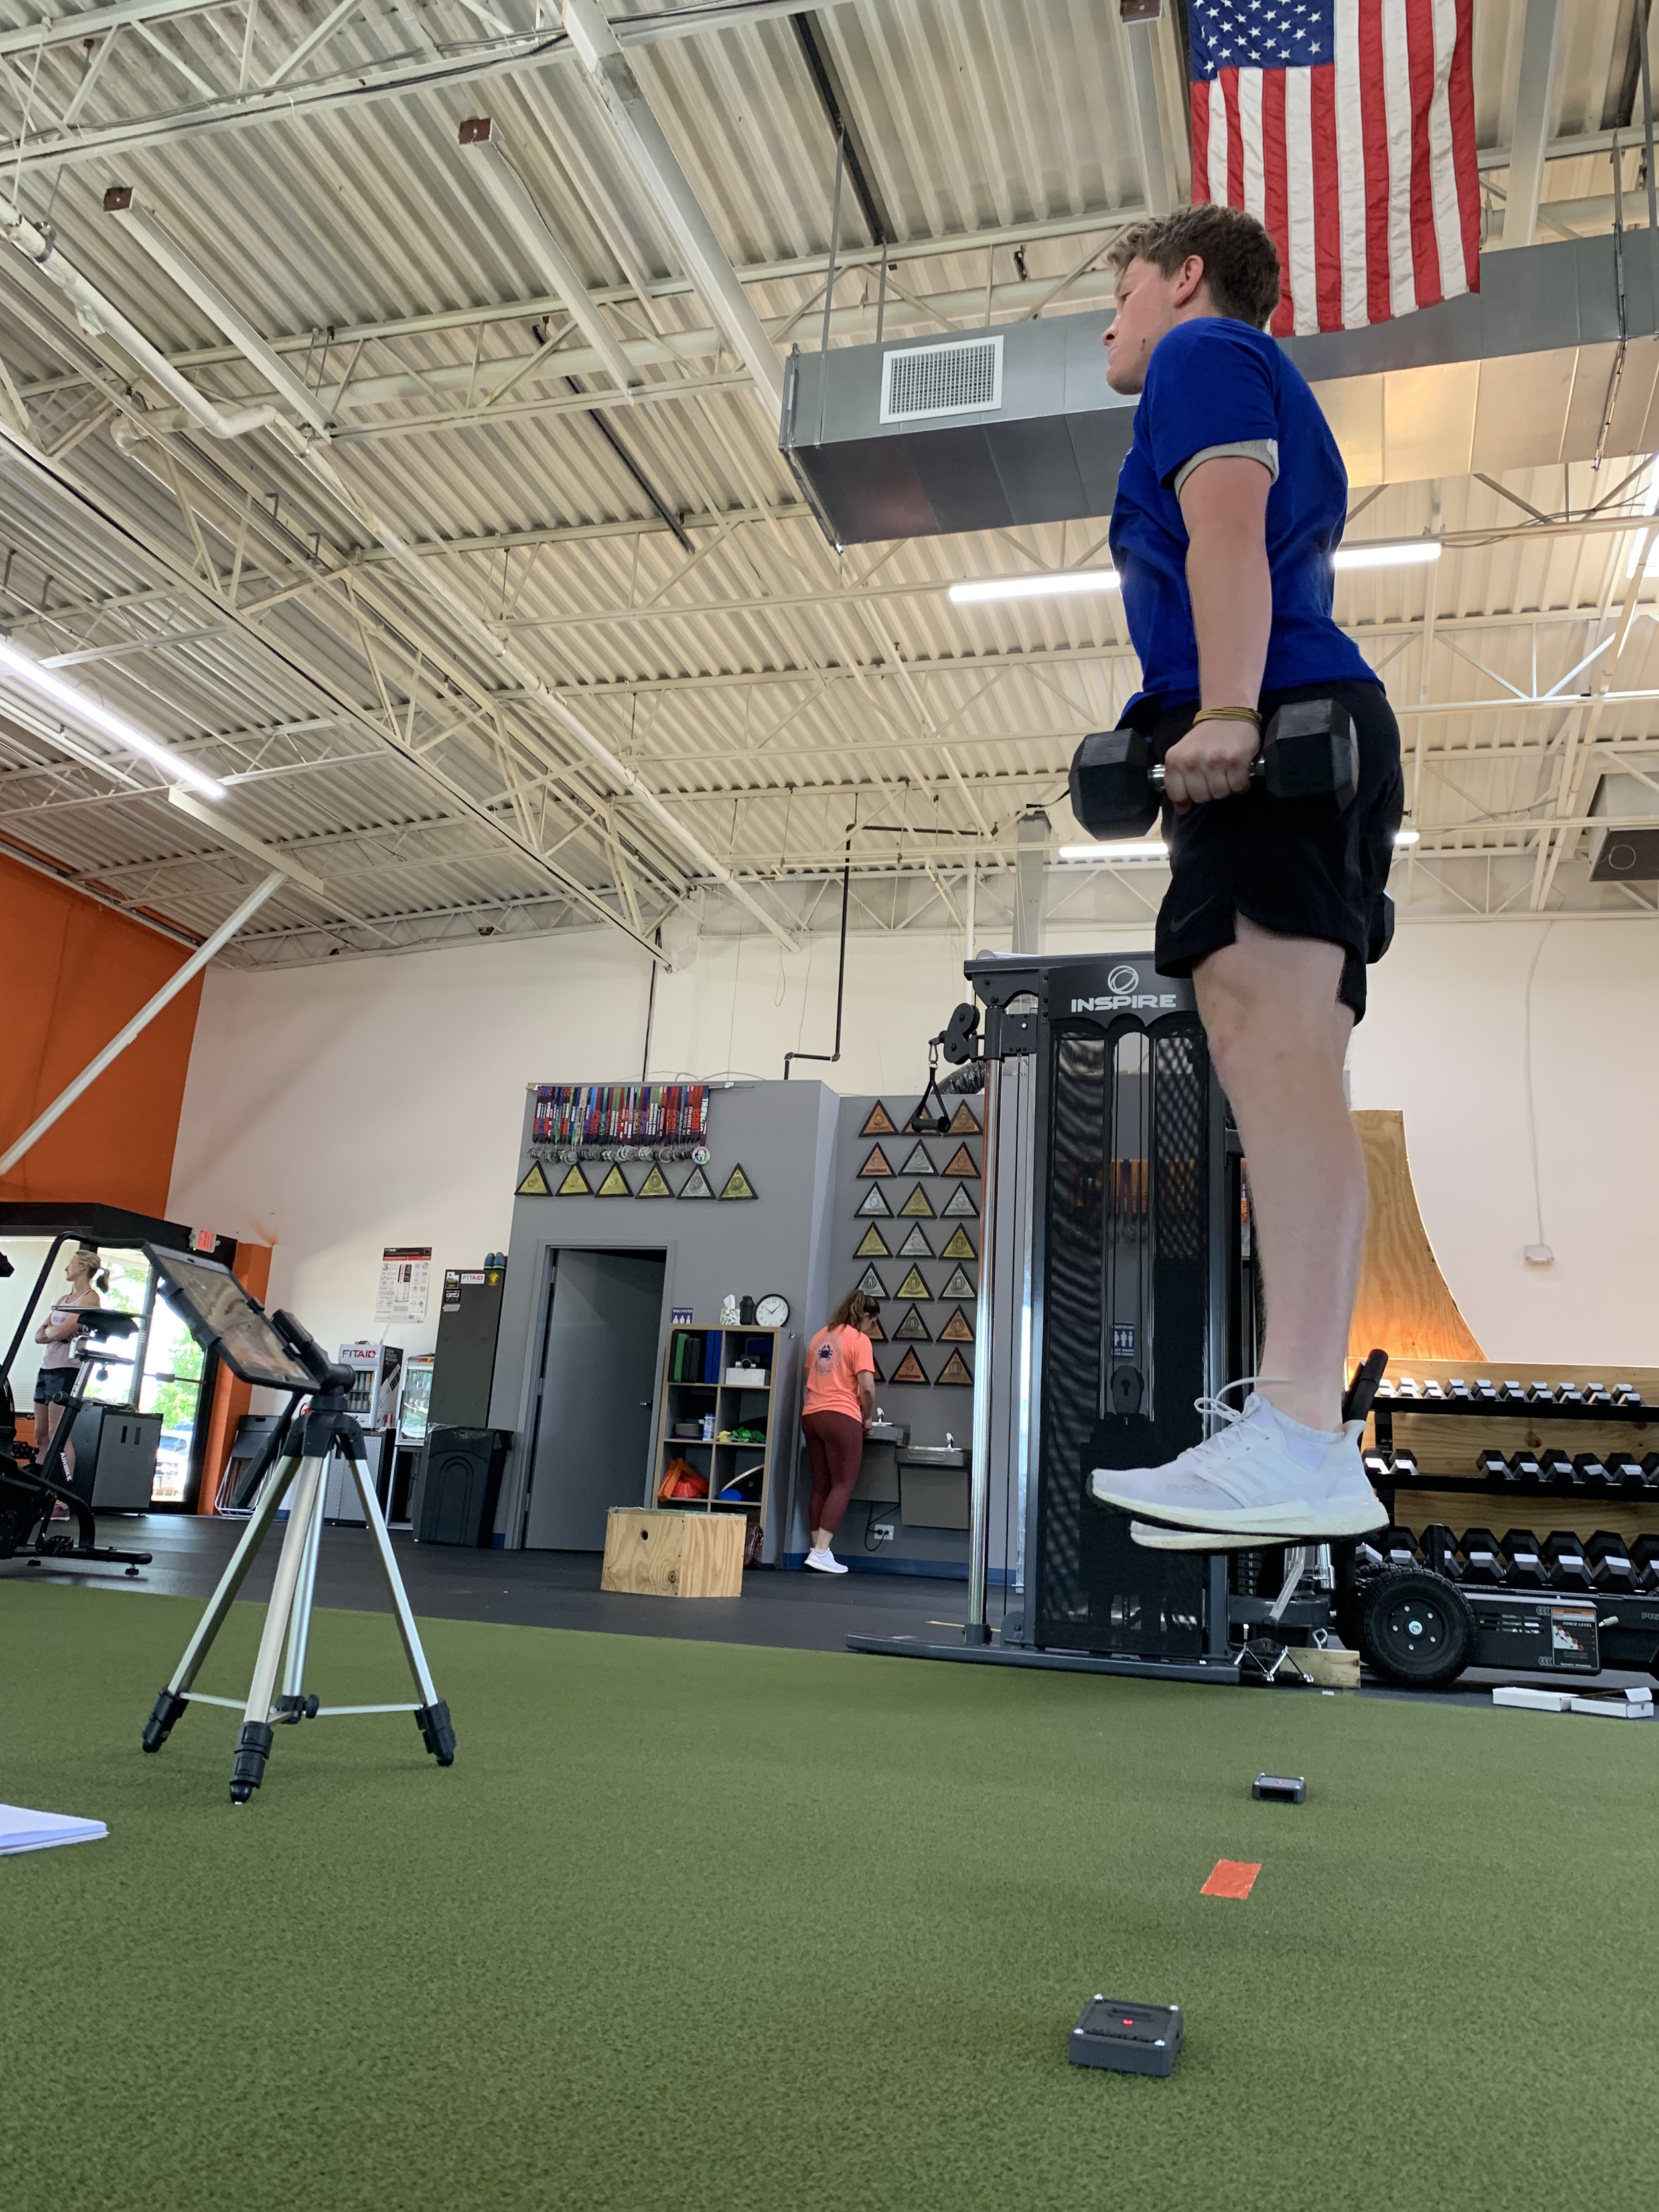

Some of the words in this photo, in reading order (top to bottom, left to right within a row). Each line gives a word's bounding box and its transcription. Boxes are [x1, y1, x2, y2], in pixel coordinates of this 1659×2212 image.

[1071, 994, 1177, 1013] INSPIRE
[198, 1230, 215, 1250] EXIT
[342, 1350, 376, 1359] FITAID
[60, 1452, 72, 1482] AIRBIKE
